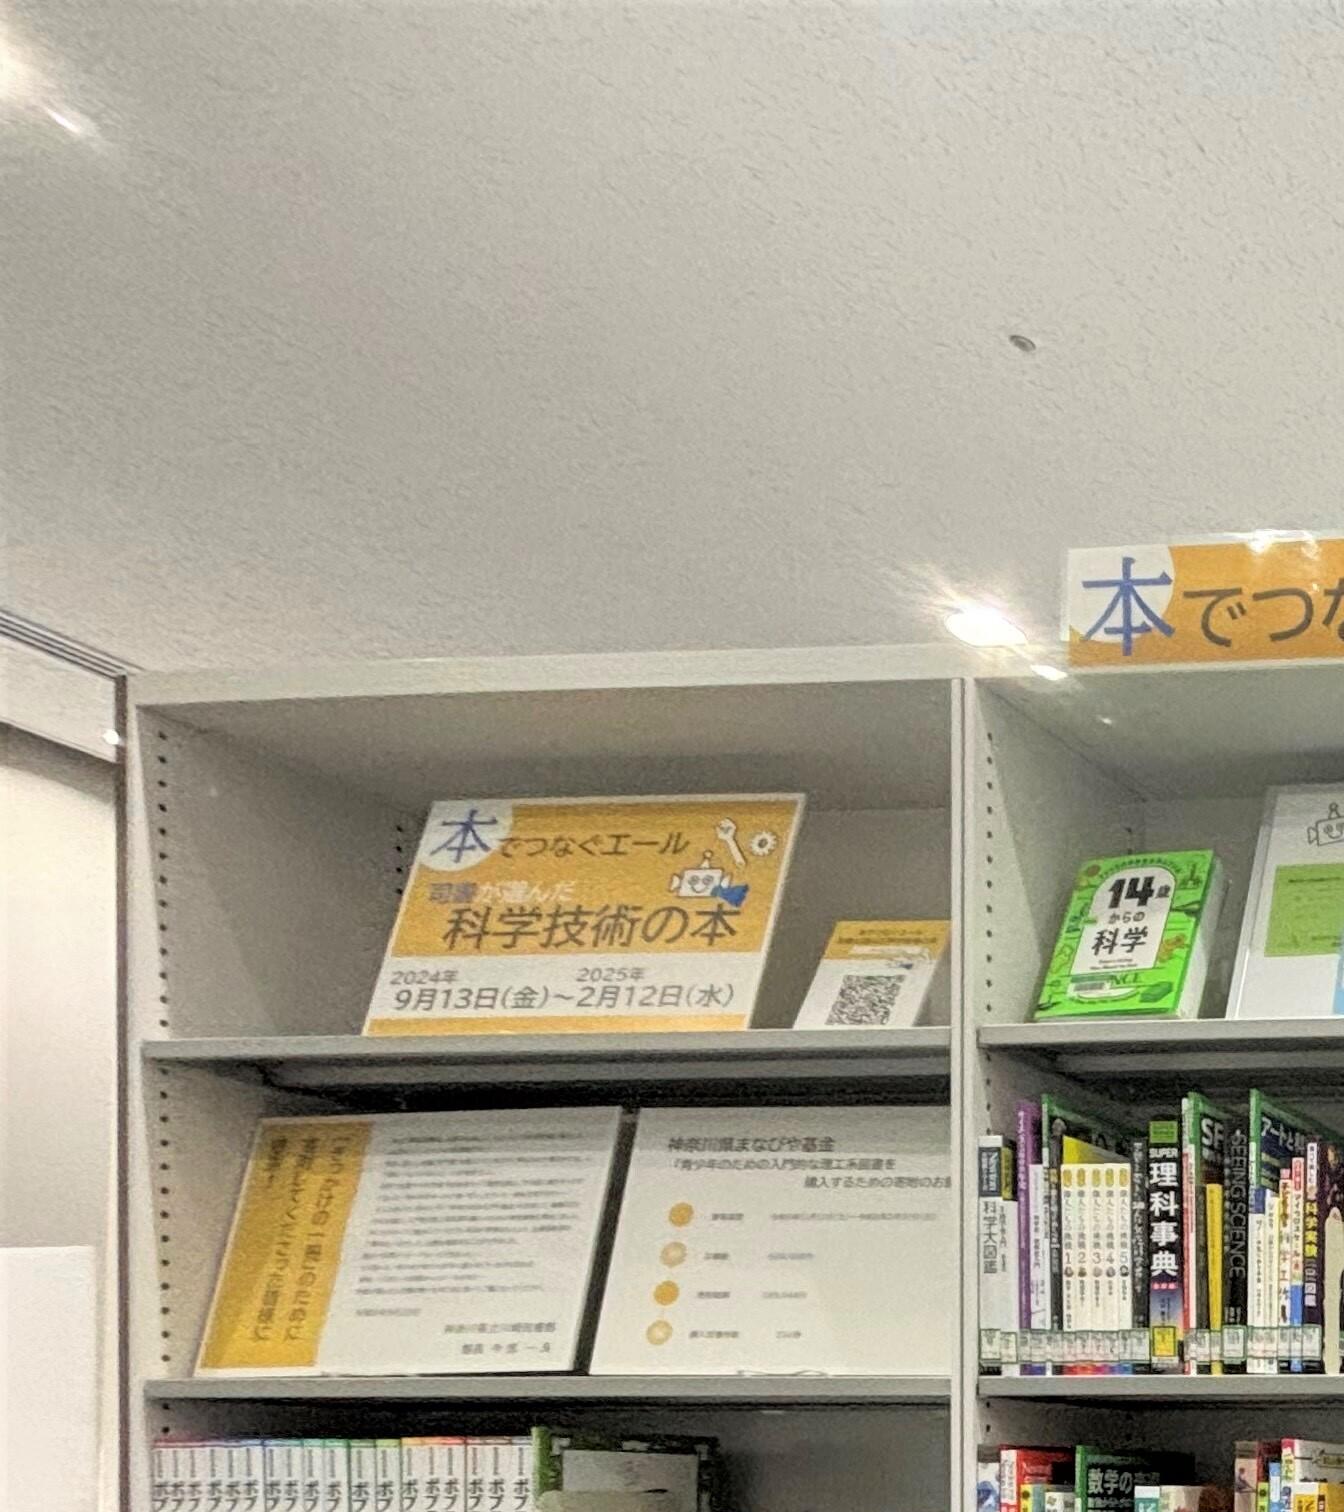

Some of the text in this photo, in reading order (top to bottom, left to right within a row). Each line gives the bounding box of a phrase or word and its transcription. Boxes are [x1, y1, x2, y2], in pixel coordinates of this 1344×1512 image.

[429, 808, 688, 864] 本でつなぐエール
[428, 880, 575, 904] 司書が選んだ
[442, 904, 740, 949] 科学技術の本
[1109, 912, 1145, 924] からの
[1092, 926, 1148, 956] 科学
[391, 967, 644, 985] 2024年 2025年
[668, 1136, 835, 1152] 神奈川県まなびや基金
[1150, 1162, 1178, 1277] 理科事典
[983, 1200, 998, 1274] 科学大図鑑
